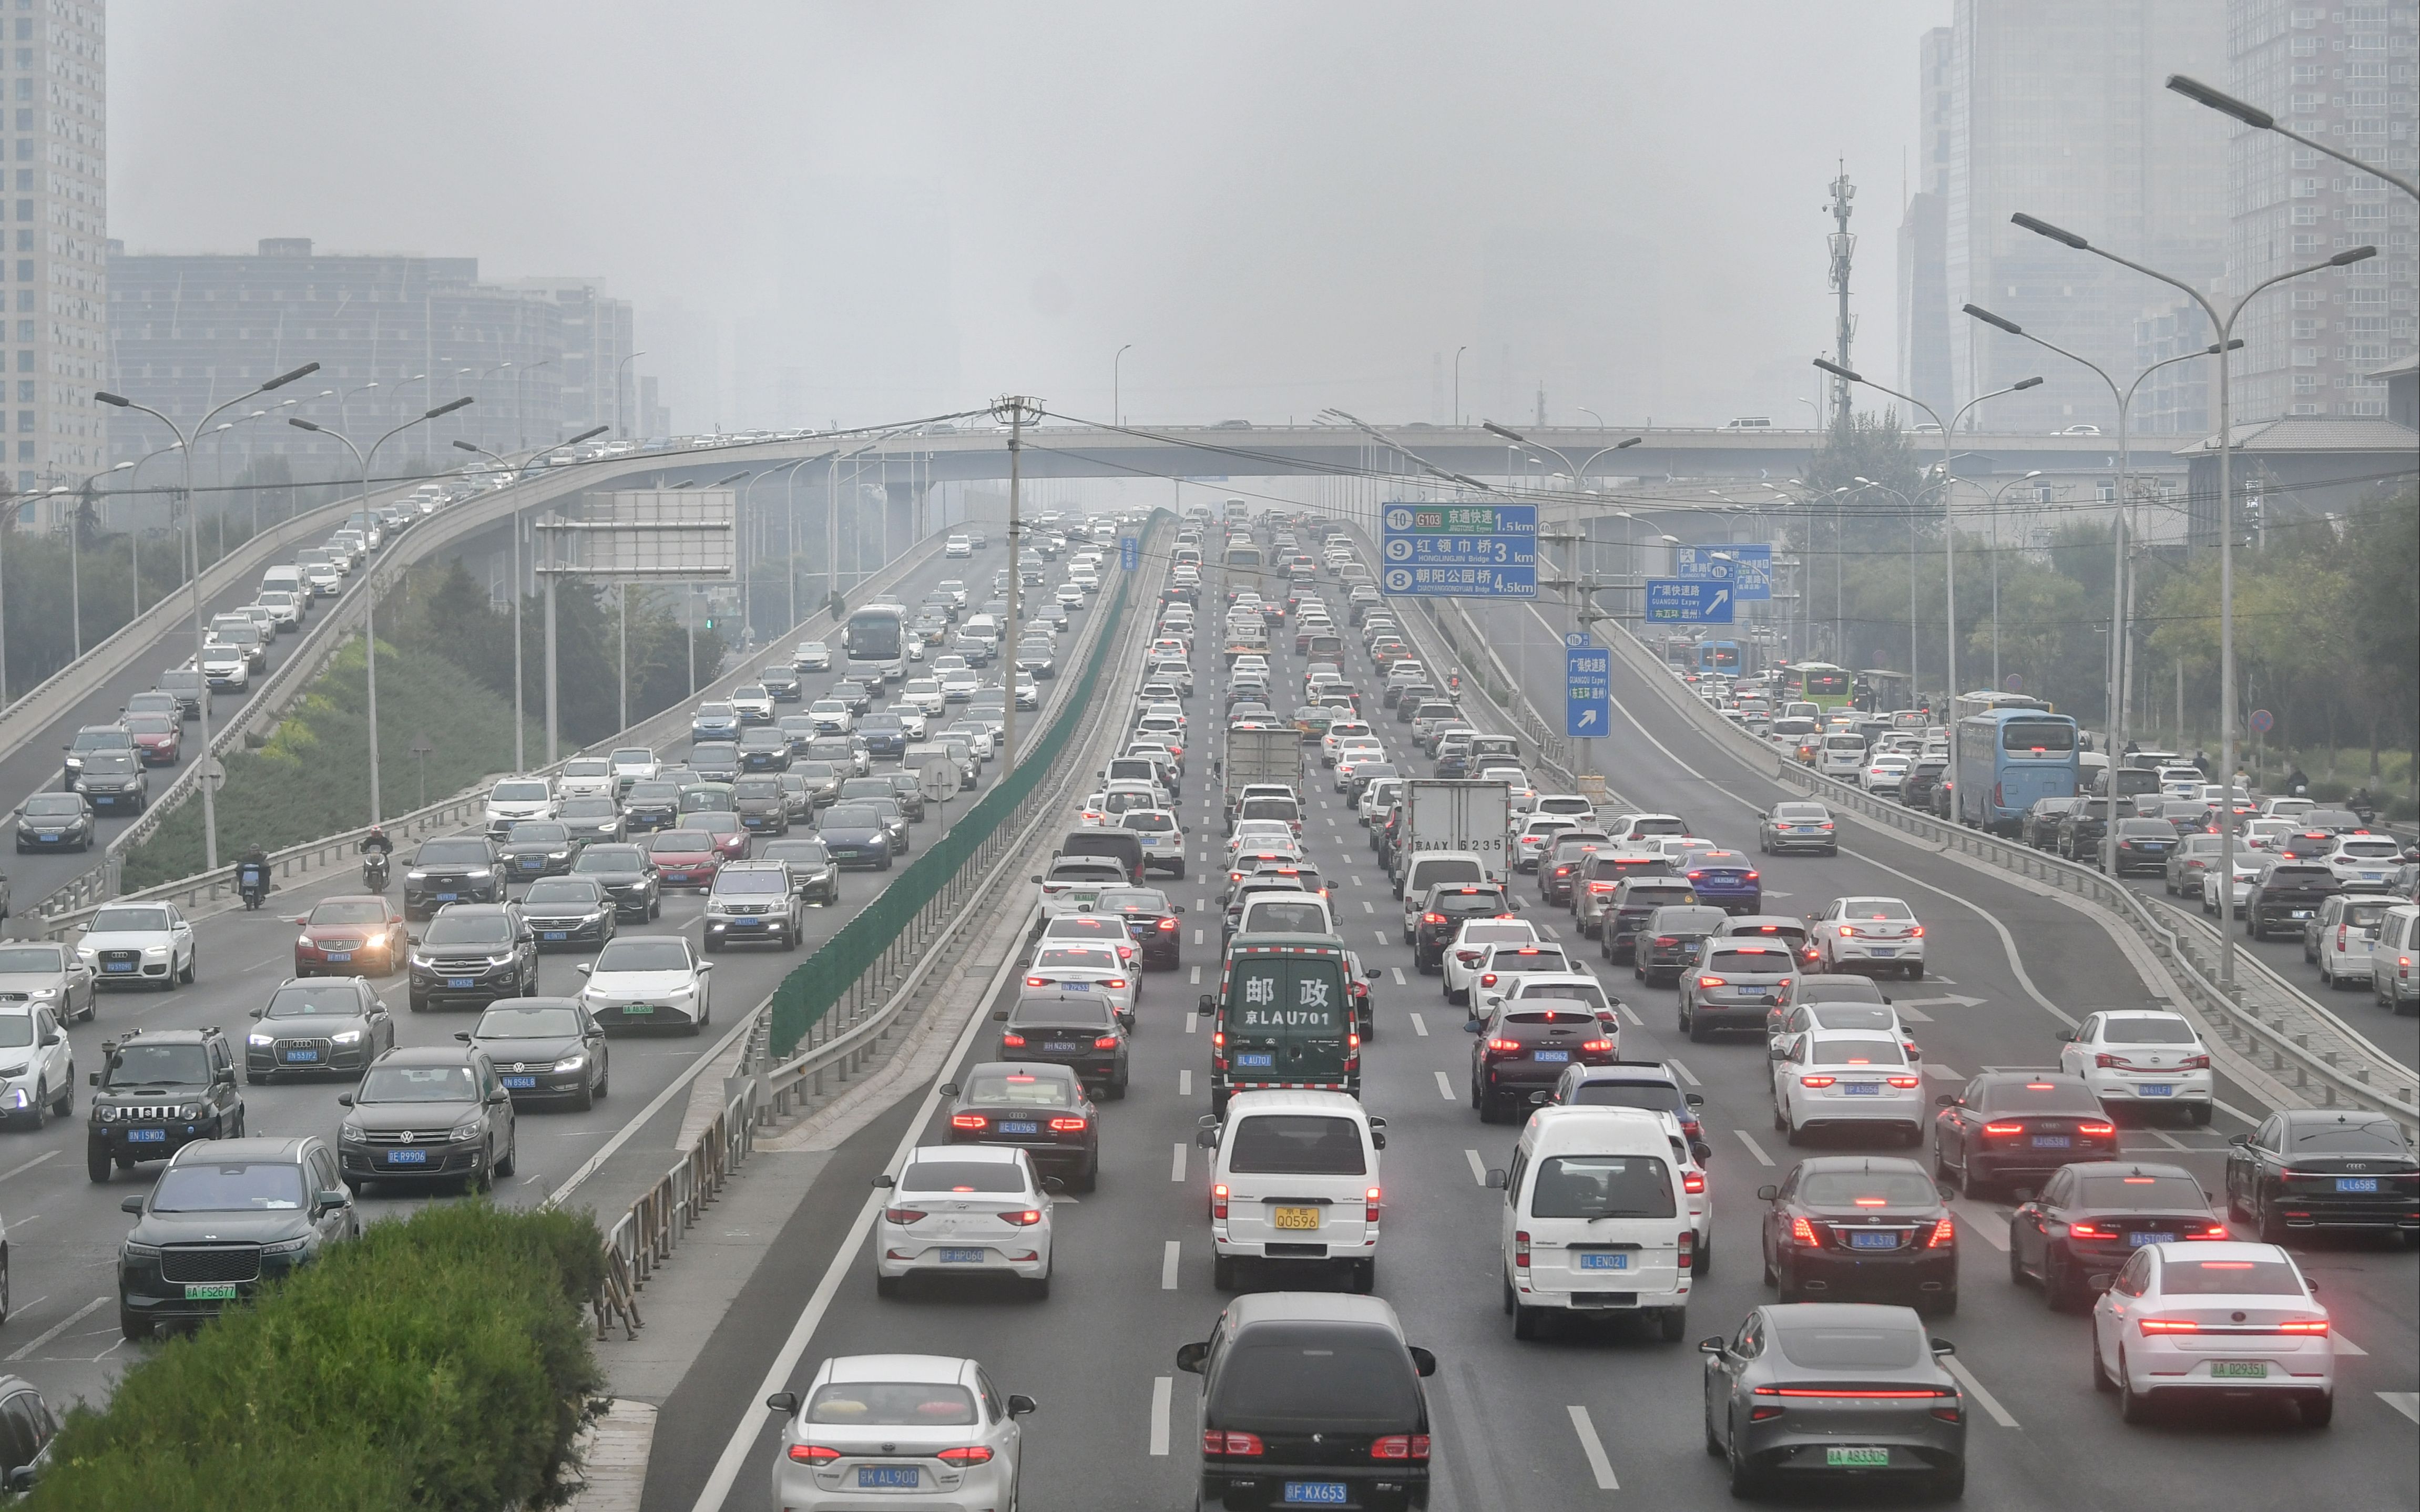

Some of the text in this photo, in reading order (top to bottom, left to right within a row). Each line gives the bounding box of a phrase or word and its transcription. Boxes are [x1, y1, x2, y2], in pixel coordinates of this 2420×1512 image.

[1393, 512, 1406, 527] 10
[1417, 514, 1440, 526] G103
[1448, 509, 1493, 524] 京通快速
[1393, 543, 1406, 557] 9
[1417, 538, 1492, 554] 红领巾桥
[1495, 543, 1534, 563] 3 km
[1468, 555, 1489, 564] Bridge
[1392, 573, 1405, 587] 8
[1415, 568, 1492, 584] 朝阳公园桥
[1652, 585, 1700, 596] 广渠快速路
[1569, 658, 1606, 672] 广渠快速路
[1245, 976, 1329, 1007] 邮政
